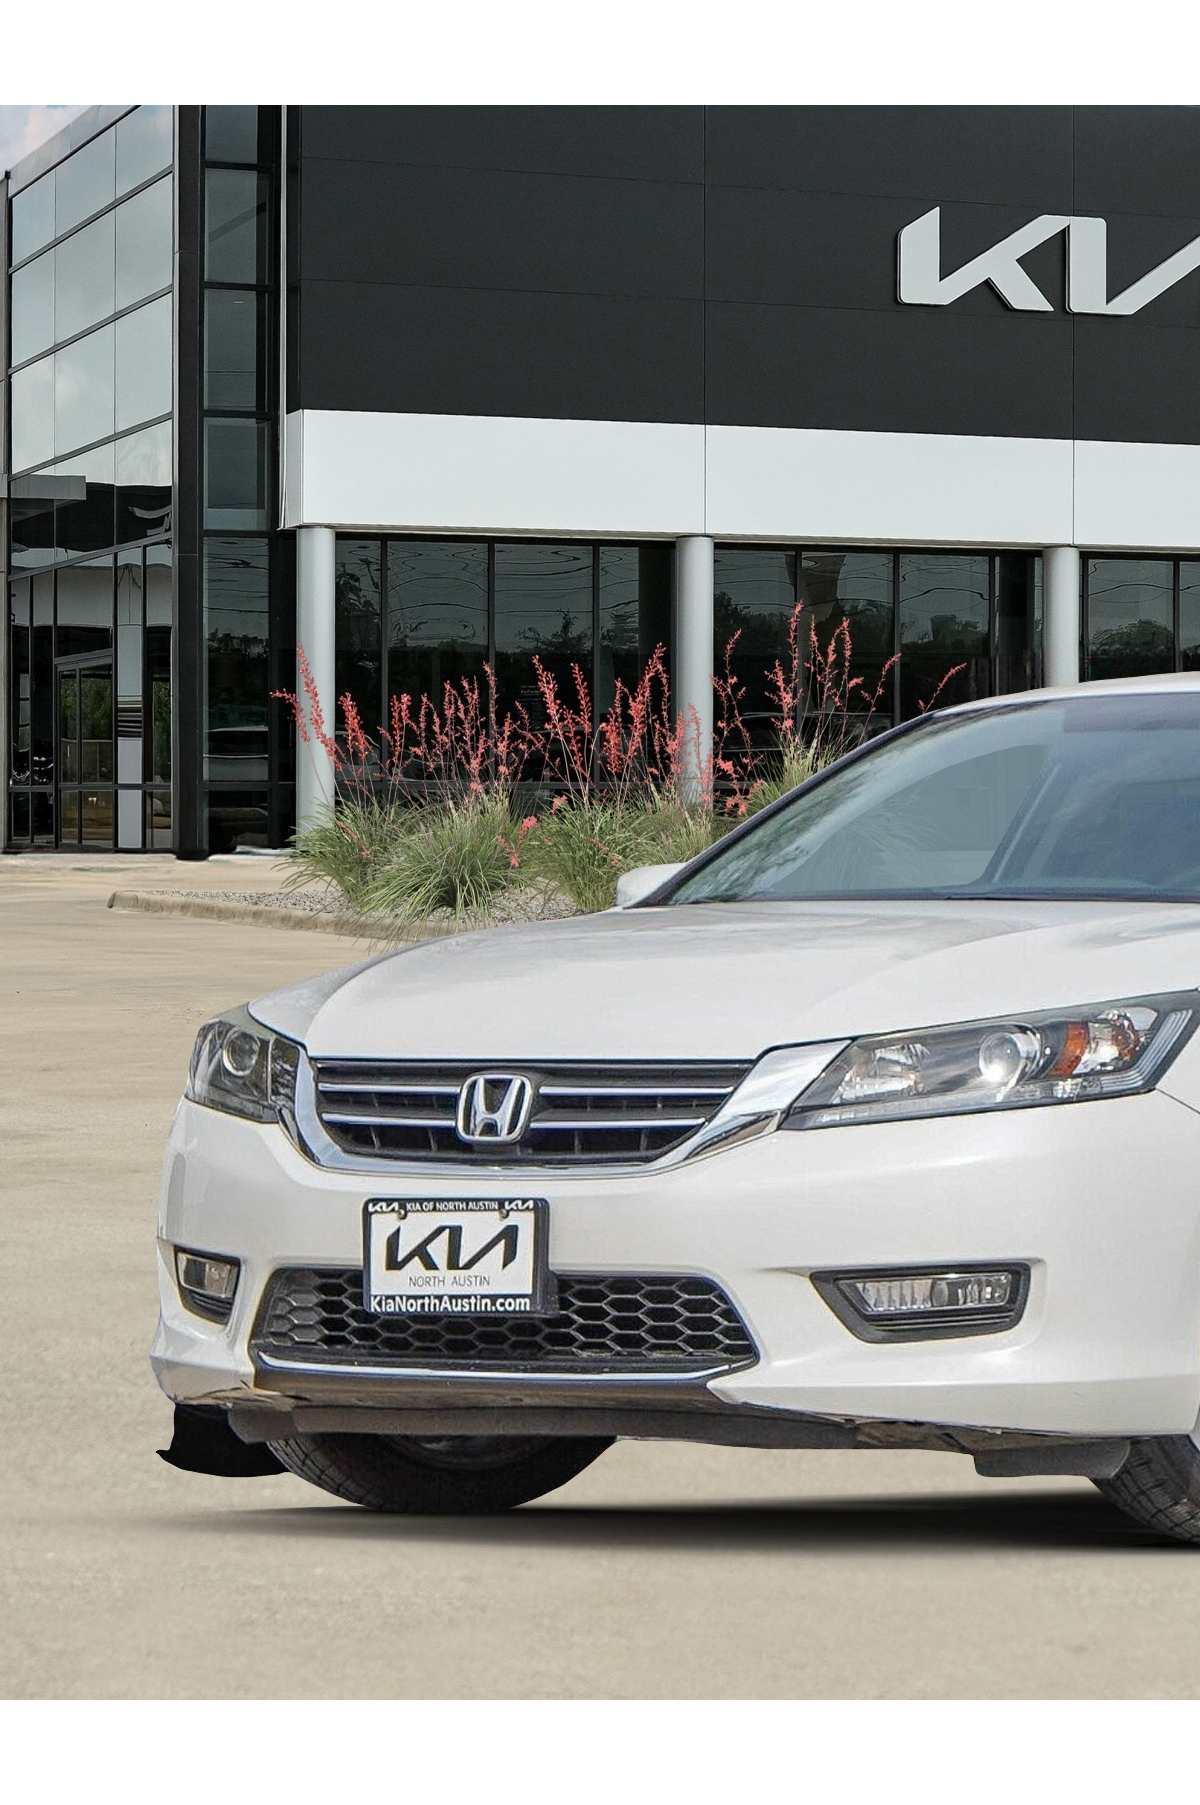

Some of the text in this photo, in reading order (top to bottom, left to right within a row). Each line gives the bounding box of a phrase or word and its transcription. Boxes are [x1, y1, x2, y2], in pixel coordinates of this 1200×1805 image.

[406, 1201, 498, 1211] KIA OF NORTH AUSTIN
[385, 1224, 519, 1271] KIA
[409, 1275, 490, 1288] NORTH AUSTIN
[371, 1295, 530, 1313] KiaNorthAustin.com
